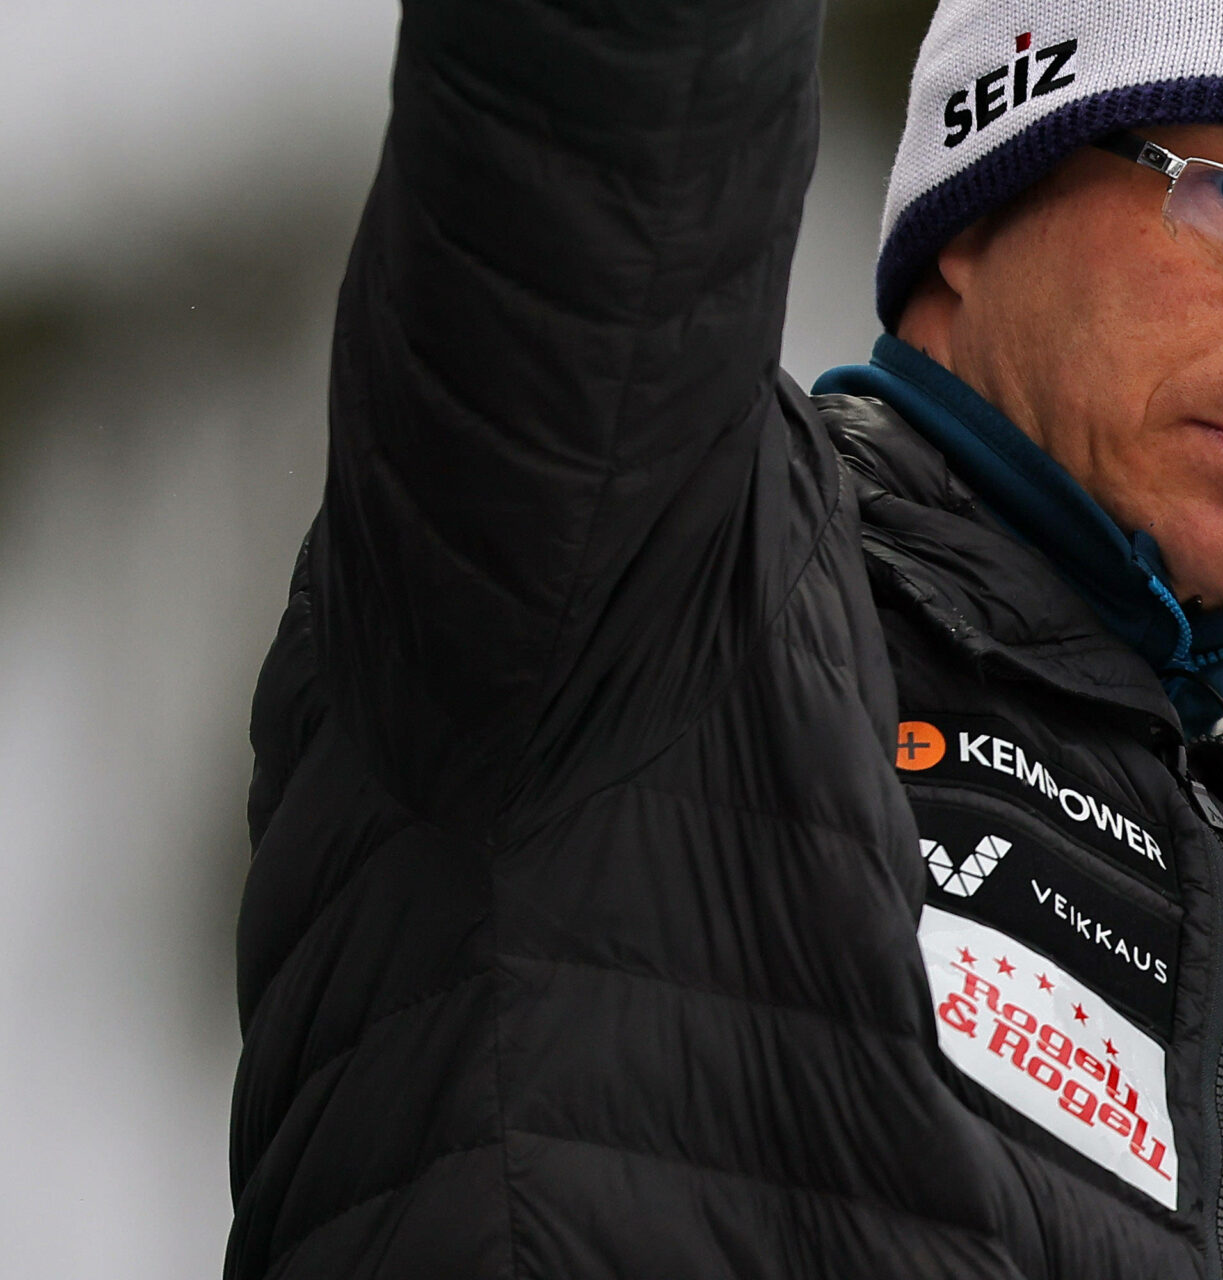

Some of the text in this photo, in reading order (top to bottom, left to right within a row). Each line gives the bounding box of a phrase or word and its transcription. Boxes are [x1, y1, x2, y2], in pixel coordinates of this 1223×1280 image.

[958, 731, 1167, 870] KEMPOWER
[1031, 879, 1168, 984] VEIKKAUS
[938, 992, 978, 1038] &
